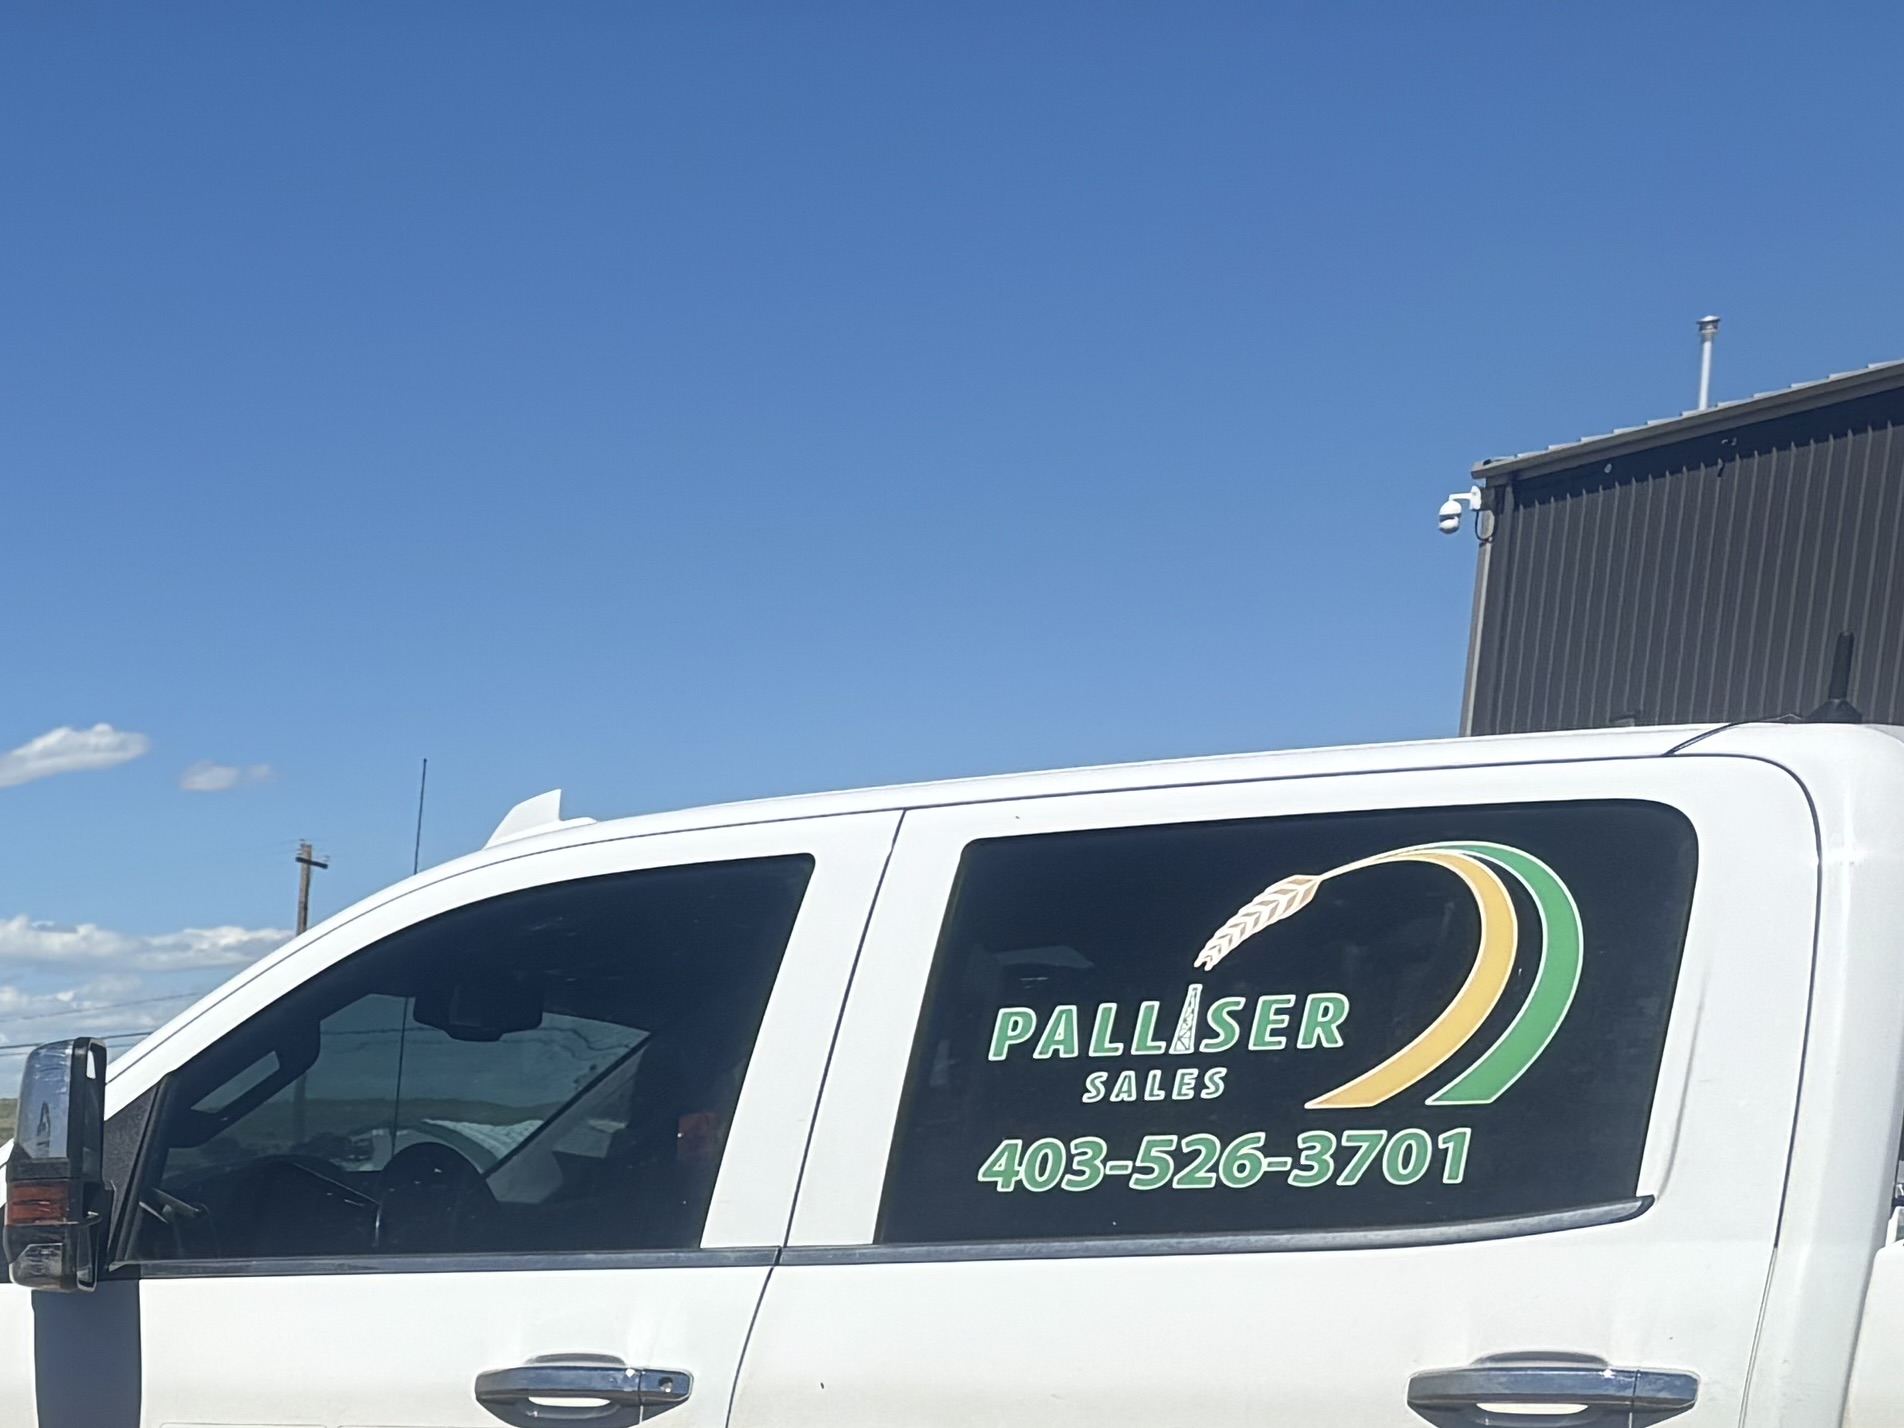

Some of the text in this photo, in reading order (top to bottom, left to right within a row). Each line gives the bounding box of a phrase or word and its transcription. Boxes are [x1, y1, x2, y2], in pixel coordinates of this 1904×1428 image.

[988, 984, 1350, 1061] PALLISER
[1082, 1067, 1227, 1104] SALES
[977, 1128, 1472, 1192] 403-526-3701
